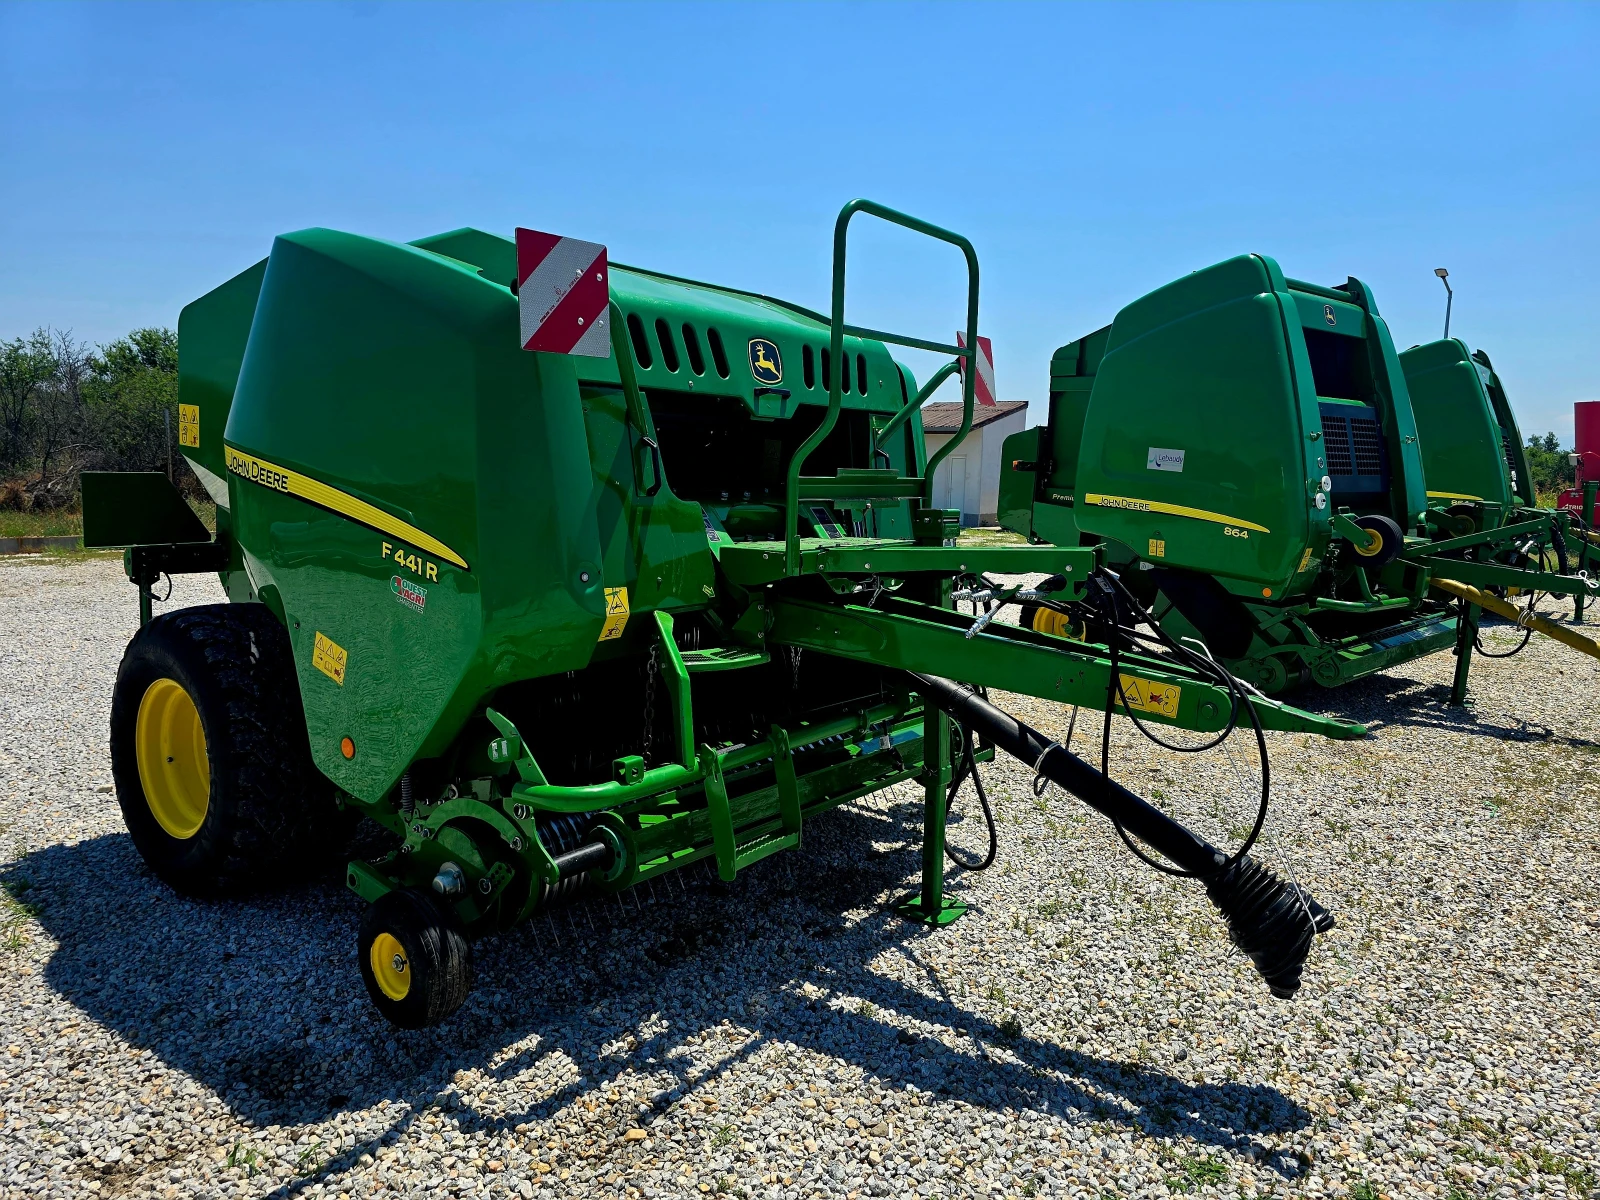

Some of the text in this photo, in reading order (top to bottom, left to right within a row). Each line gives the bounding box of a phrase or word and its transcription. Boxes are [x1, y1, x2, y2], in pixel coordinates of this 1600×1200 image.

[1158, 454, 1184, 464] Lebaudy
[228, 451, 289, 492] JOHN DEERE
[1098, 496, 1150, 512] JOHN DEERE
[1224, 526, 1248, 539] 864
[382, 541, 438, 583] F 441 R
[402, 579, 427, 597] OUEST
[403, 589, 425, 607] AGRI
